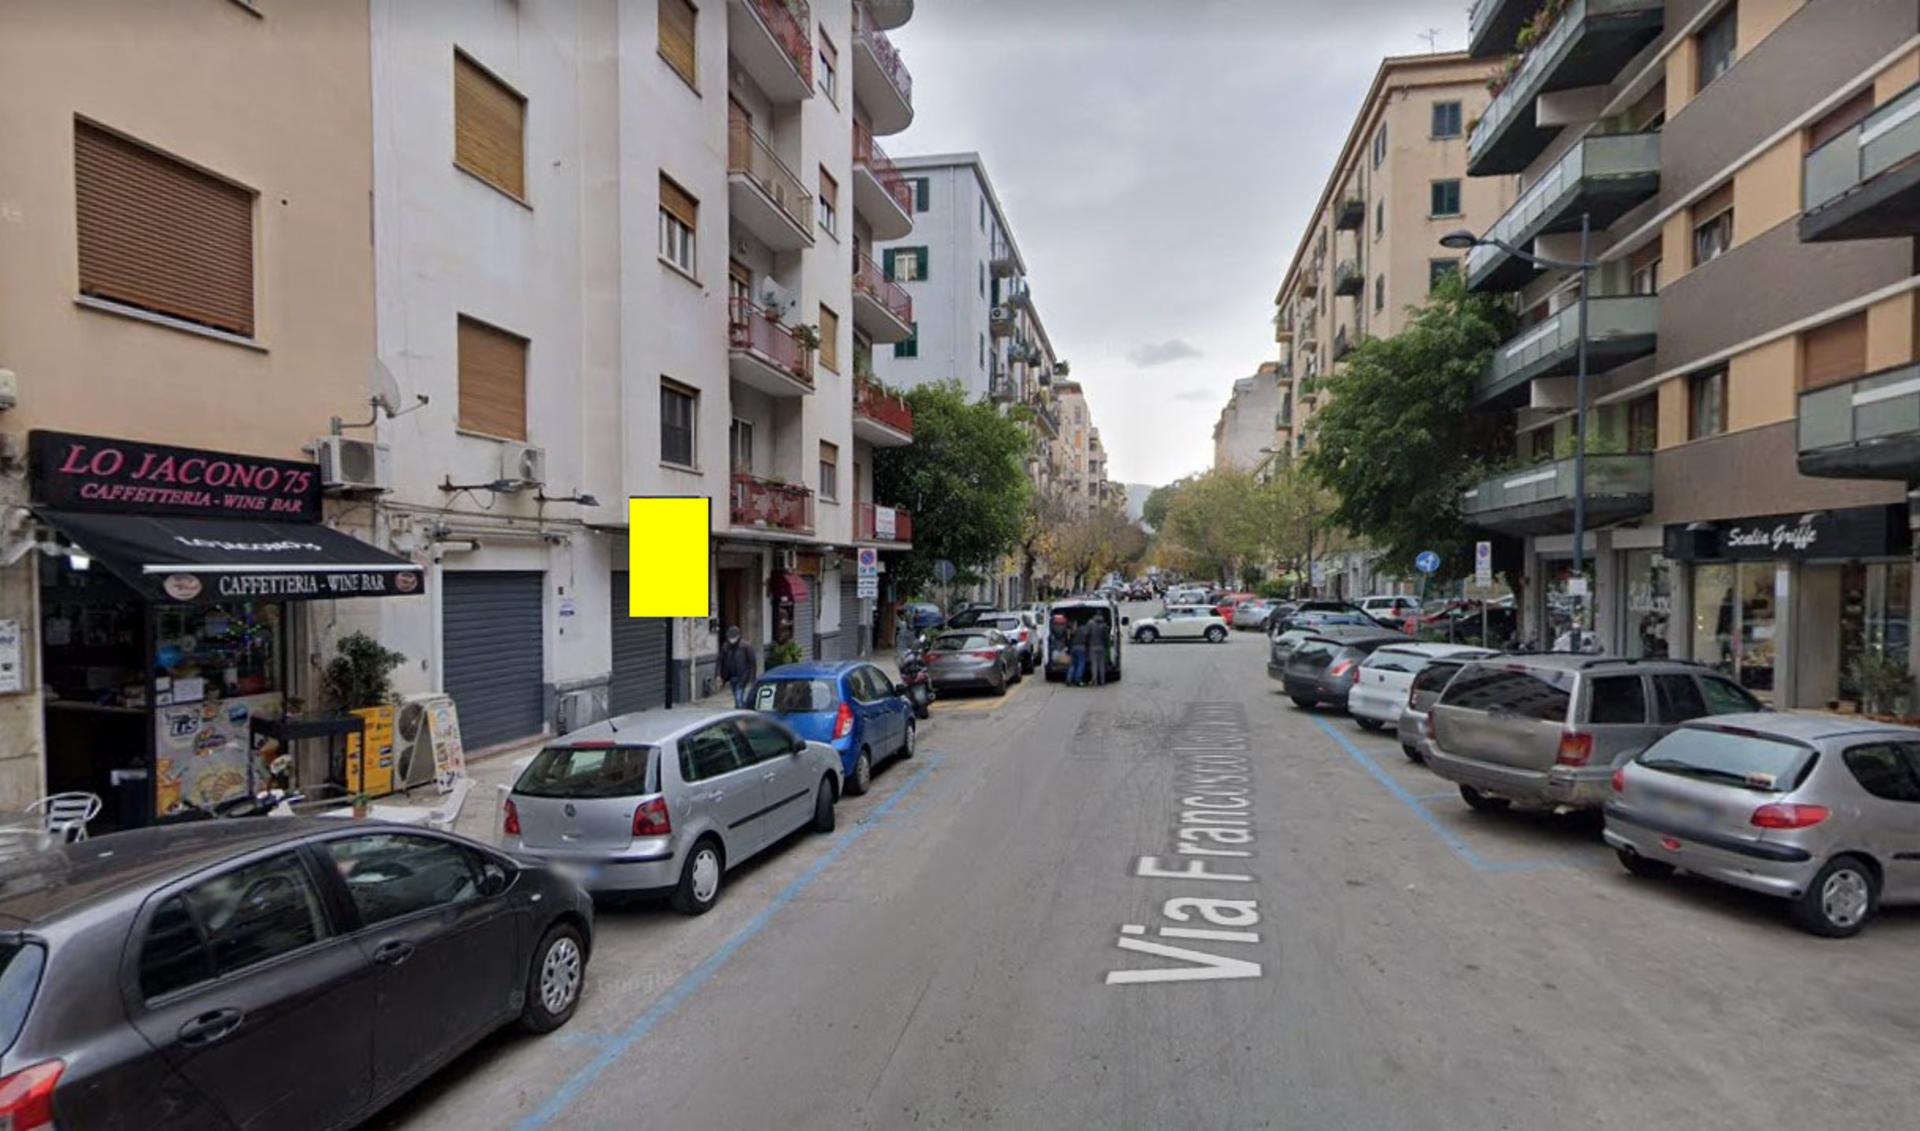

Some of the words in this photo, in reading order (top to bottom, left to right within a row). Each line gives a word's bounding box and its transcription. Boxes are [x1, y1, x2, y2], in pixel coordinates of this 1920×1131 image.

[60, 444, 124, 476] LO
[131, 453, 280, 490] JACONO
[283, 469, 312, 494] 75
[80, 483, 211, 507] CAFFETTERIA
[223, 494, 267, 509] WINE
[270, 497, 303, 512] BAR
[219, 575, 318, 597] CAFFETTERIA
[327, 574, 360, 592] WINE
[362, 574, 386, 591] BAR
